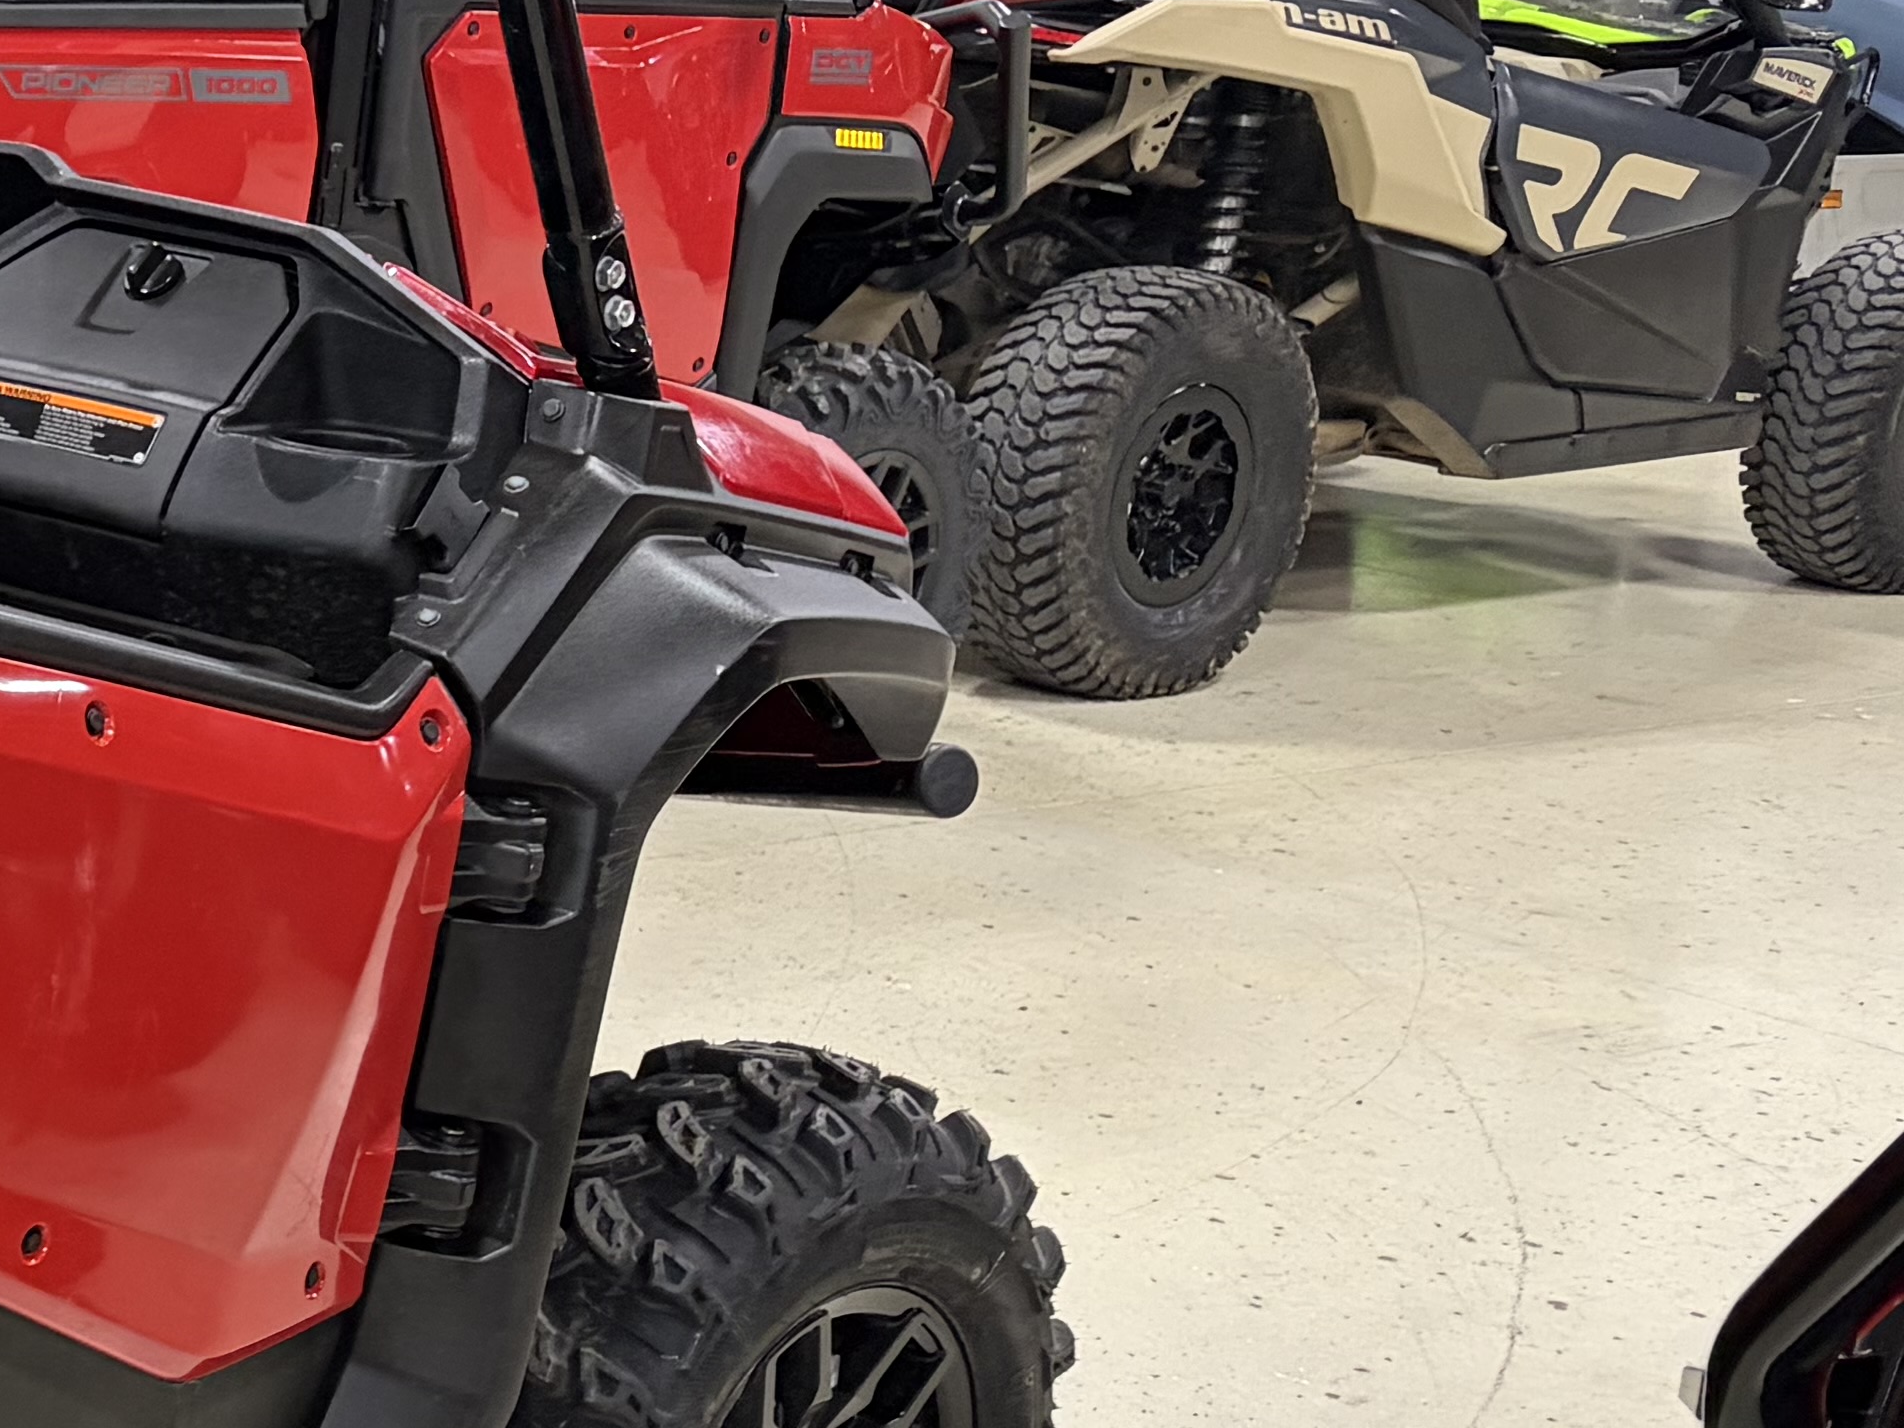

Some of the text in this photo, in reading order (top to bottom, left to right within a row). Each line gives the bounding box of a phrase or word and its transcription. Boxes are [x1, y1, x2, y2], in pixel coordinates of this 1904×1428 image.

[1271, 0, 1392, 42] n-am
[20, 72, 278, 95] PIONEER 1000
[4, 385, 52, 403] WARNING
